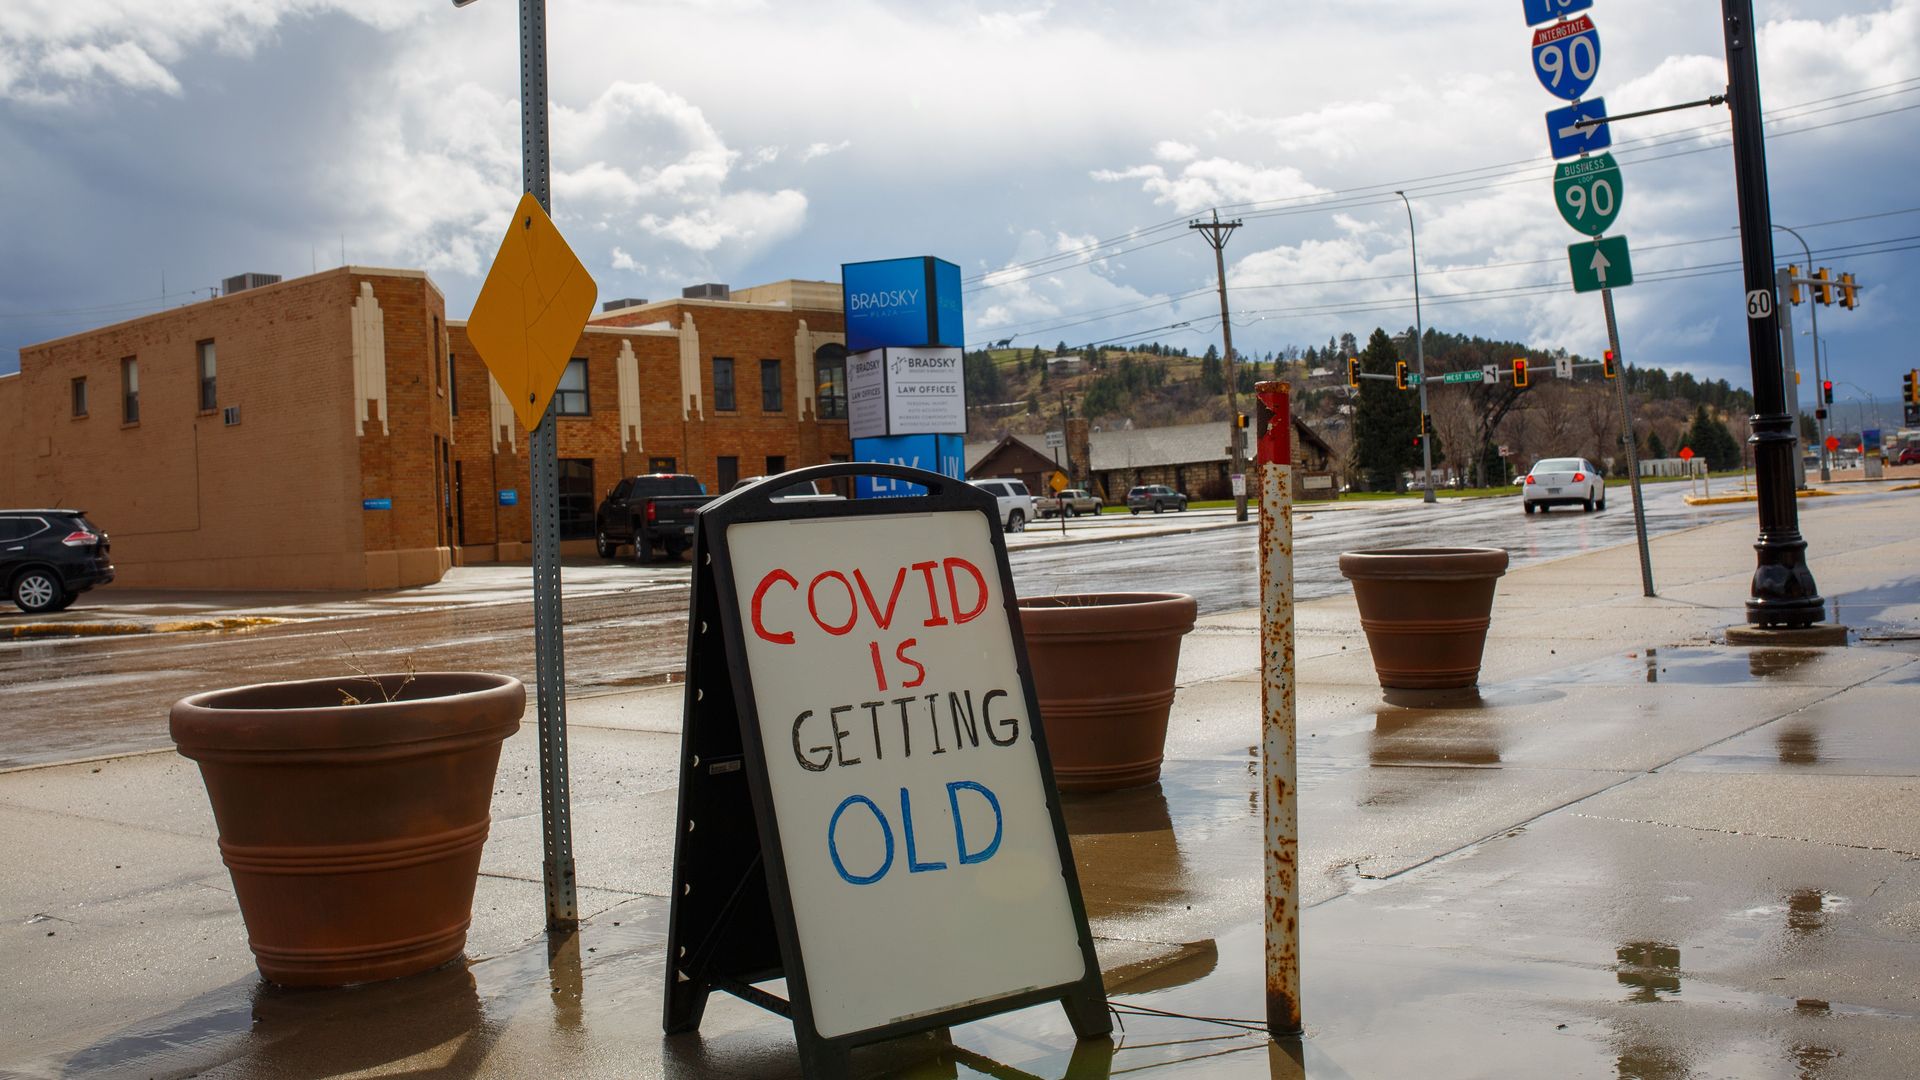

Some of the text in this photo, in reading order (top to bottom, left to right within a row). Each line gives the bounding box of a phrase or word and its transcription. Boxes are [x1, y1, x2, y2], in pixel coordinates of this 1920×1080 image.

[1538, 20, 1586, 43] INTERSTATE
[1538, 35, 1596, 88] 90
[1564, 158, 1605, 177] BUSINESS
[1578, 174, 1594, 184] LOOP
[1565, 179, 1614, 220] 90
[851, 288, 919, 311] BRADSKY
[1748, 291, 1770, 315] 60
[908, 357, 957, 368] BRADSKY
[1445, 372, 1480, 382] WEST BLVD
[897, 385, 956, 394] LAW OFFICES
[751, 557, 988, 644] COVID
[869, 638, 925, 691] IS
[792, 689, 1019, 772] GETTING
[828, 780, 1002, 885] OLD
